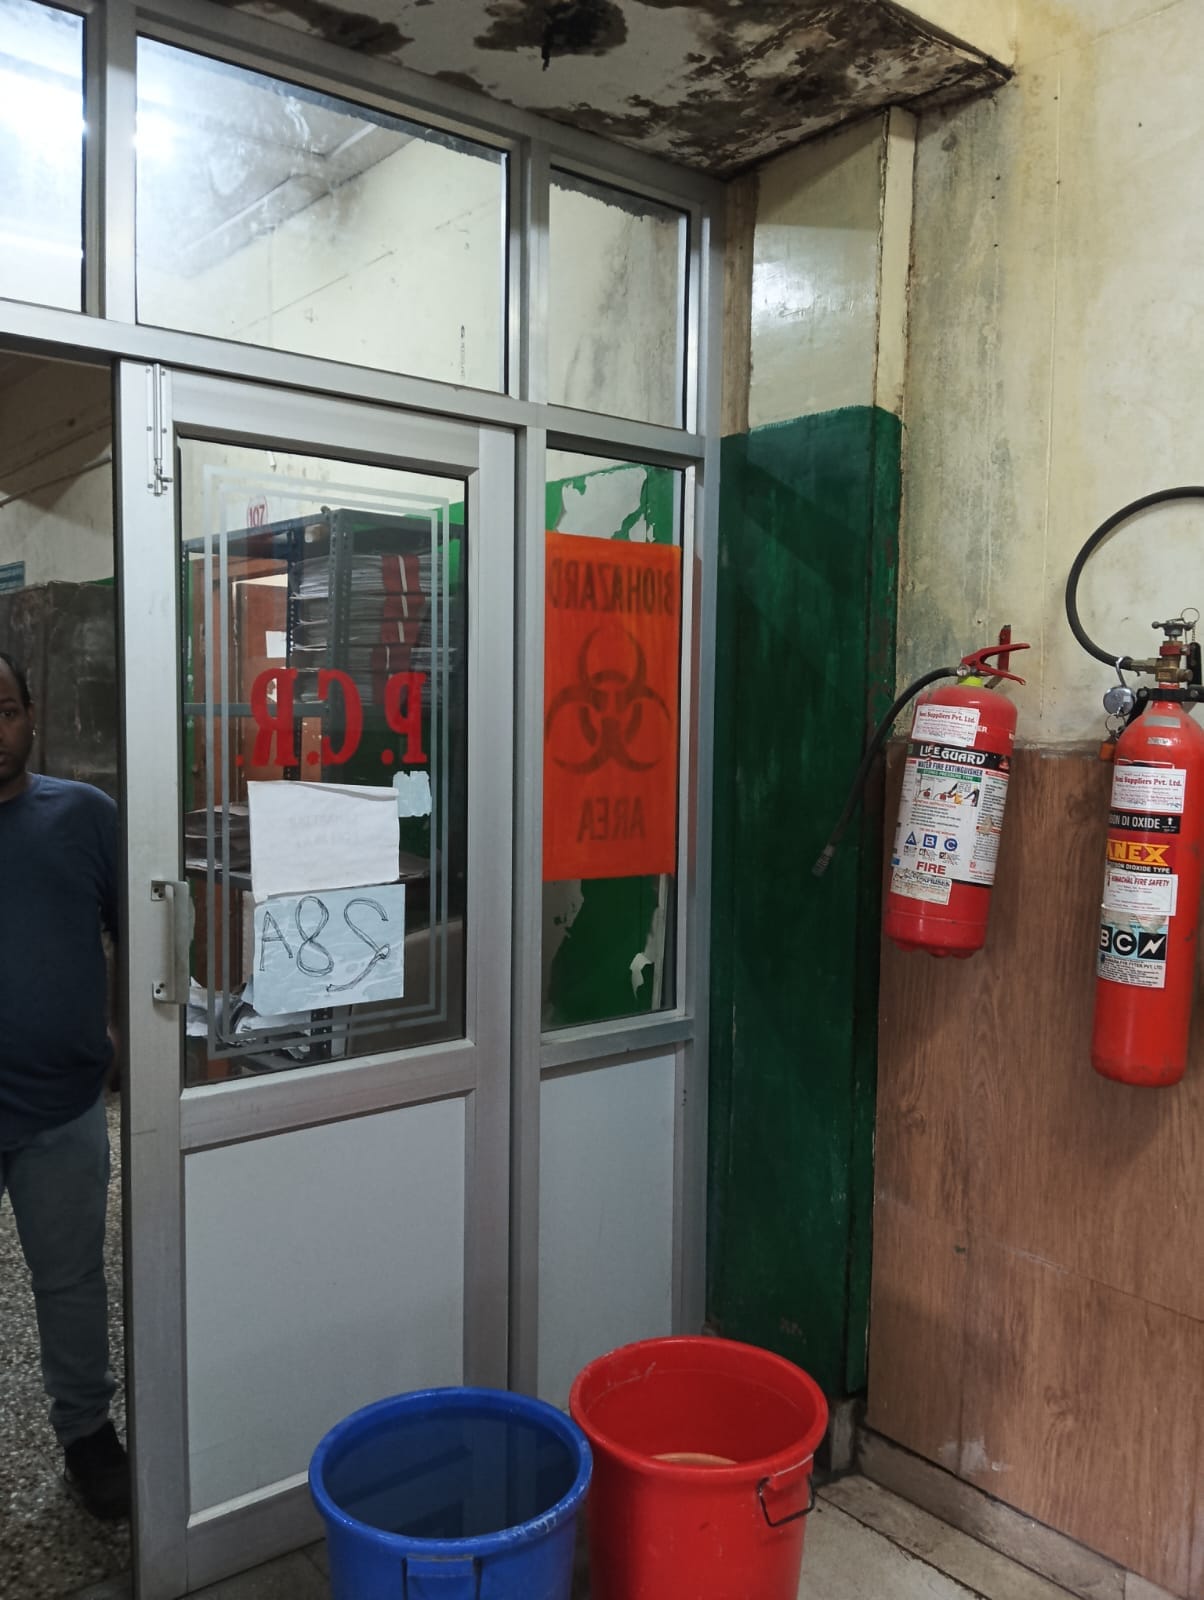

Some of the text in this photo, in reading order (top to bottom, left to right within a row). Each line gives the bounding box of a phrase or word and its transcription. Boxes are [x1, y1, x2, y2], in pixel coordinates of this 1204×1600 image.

[951, 713, 963, 721] Pvt.
[964, 715, 976, 723] Ltd.
[932, 762, 944, 771] FIRE
[944, 764, 983, 777] EXTINGUISHER
[1123, 776, 1152, 786] Suppliers
[1153, 778, 1167, 786] Pvt.
[1168, 779, 1182, 787] Ltd.
[1121, 815, 1130, 826] DI
[1131, 816, 1161, 829] OXIDE
[916, 861, 946, 875] FIRE
[1125, 863, 1151, 872] DIOXIDE
[1153, 865, 1171, 874] TYPE
[1133, 878, 1148, 886] FIRE
[1148, 879, 1169, 887] SAFETY
